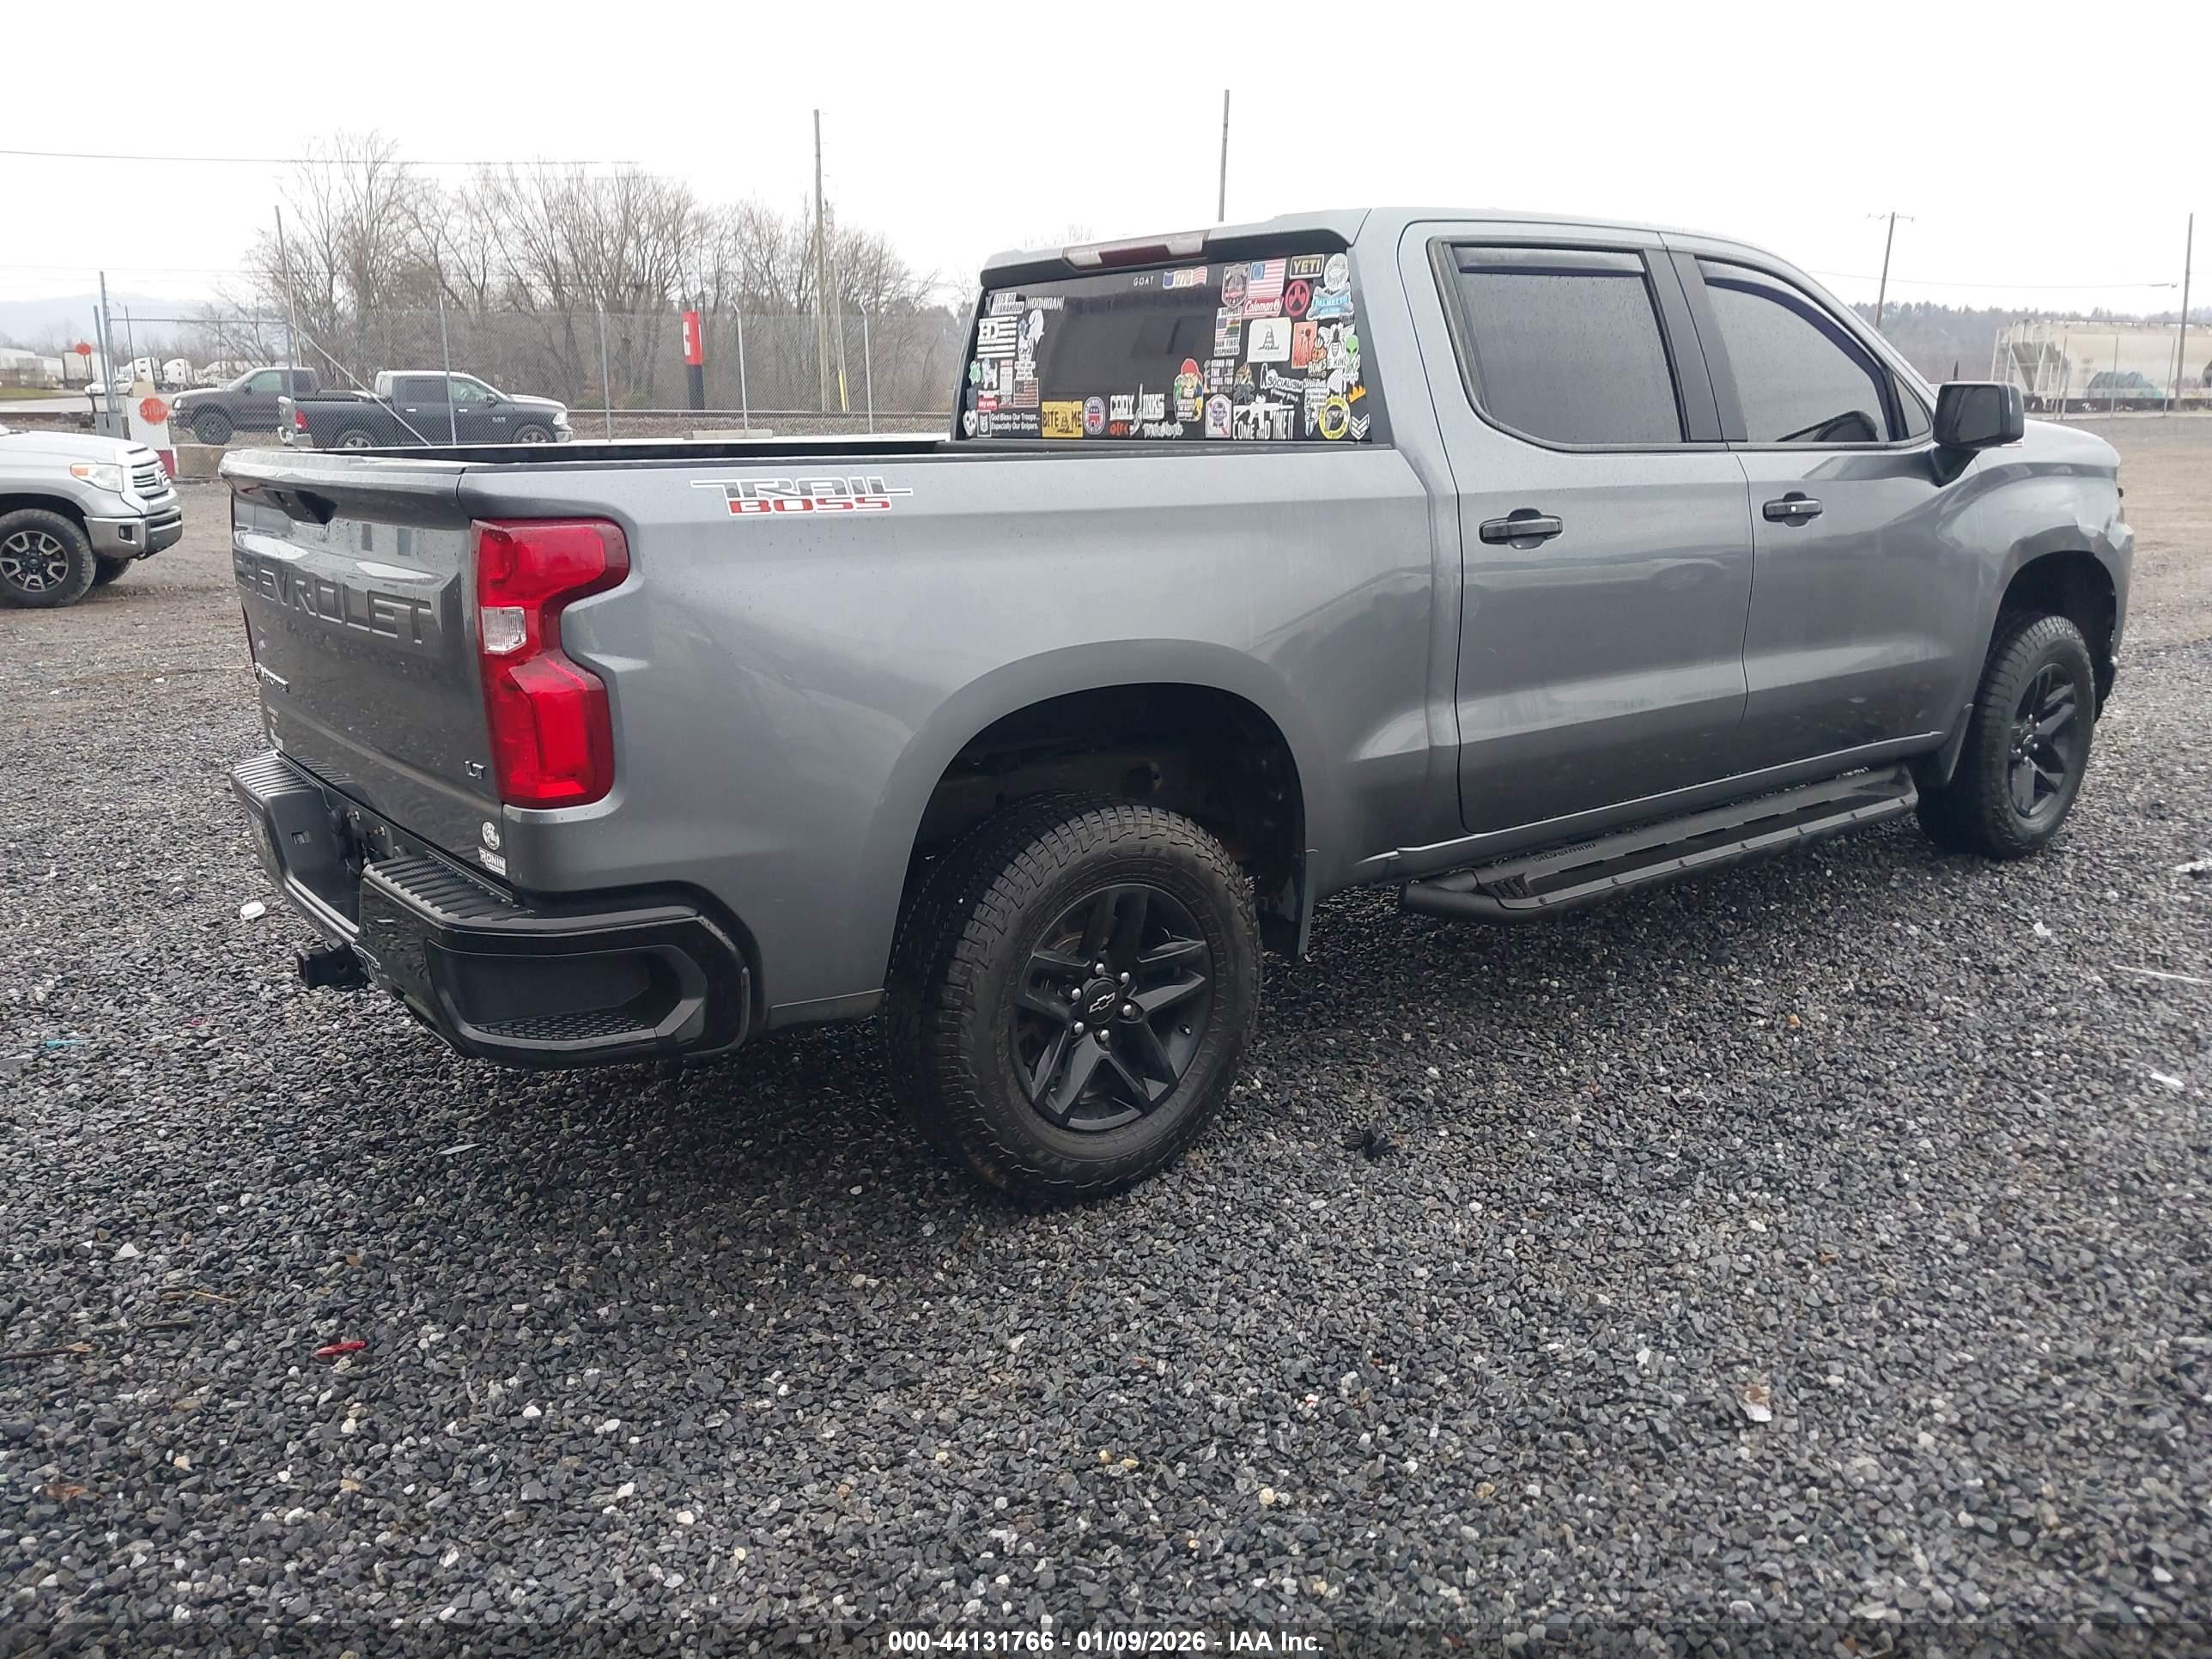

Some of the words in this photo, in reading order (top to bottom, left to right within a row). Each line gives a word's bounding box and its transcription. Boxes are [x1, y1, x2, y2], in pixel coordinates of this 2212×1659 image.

[1294, 259, 1321, 274] YETI
[1133, 276, 1154, 287] GOAT
[1244, 300, 1273, 313] Coleman
[1308, 358, 1328, 374] BONES
[1267, 375, 1303, 392] SOCIALISM
[141, 404, 168, 418] STOP
[1043, 411, 1059, 428] BITE
[1071, 410, 1082, 428] ME
[991, 422, 1012, 432] Especially
[1233, 421, 1255, 440] COME
[1273, 410, 1287, 441] TAKE
[690, 477, 914, 499] TRAIL
[728, 497, 892, 515] BOSS
[465, 760, 486, 780] LT
[478, 848, 507, 871] RONIN
